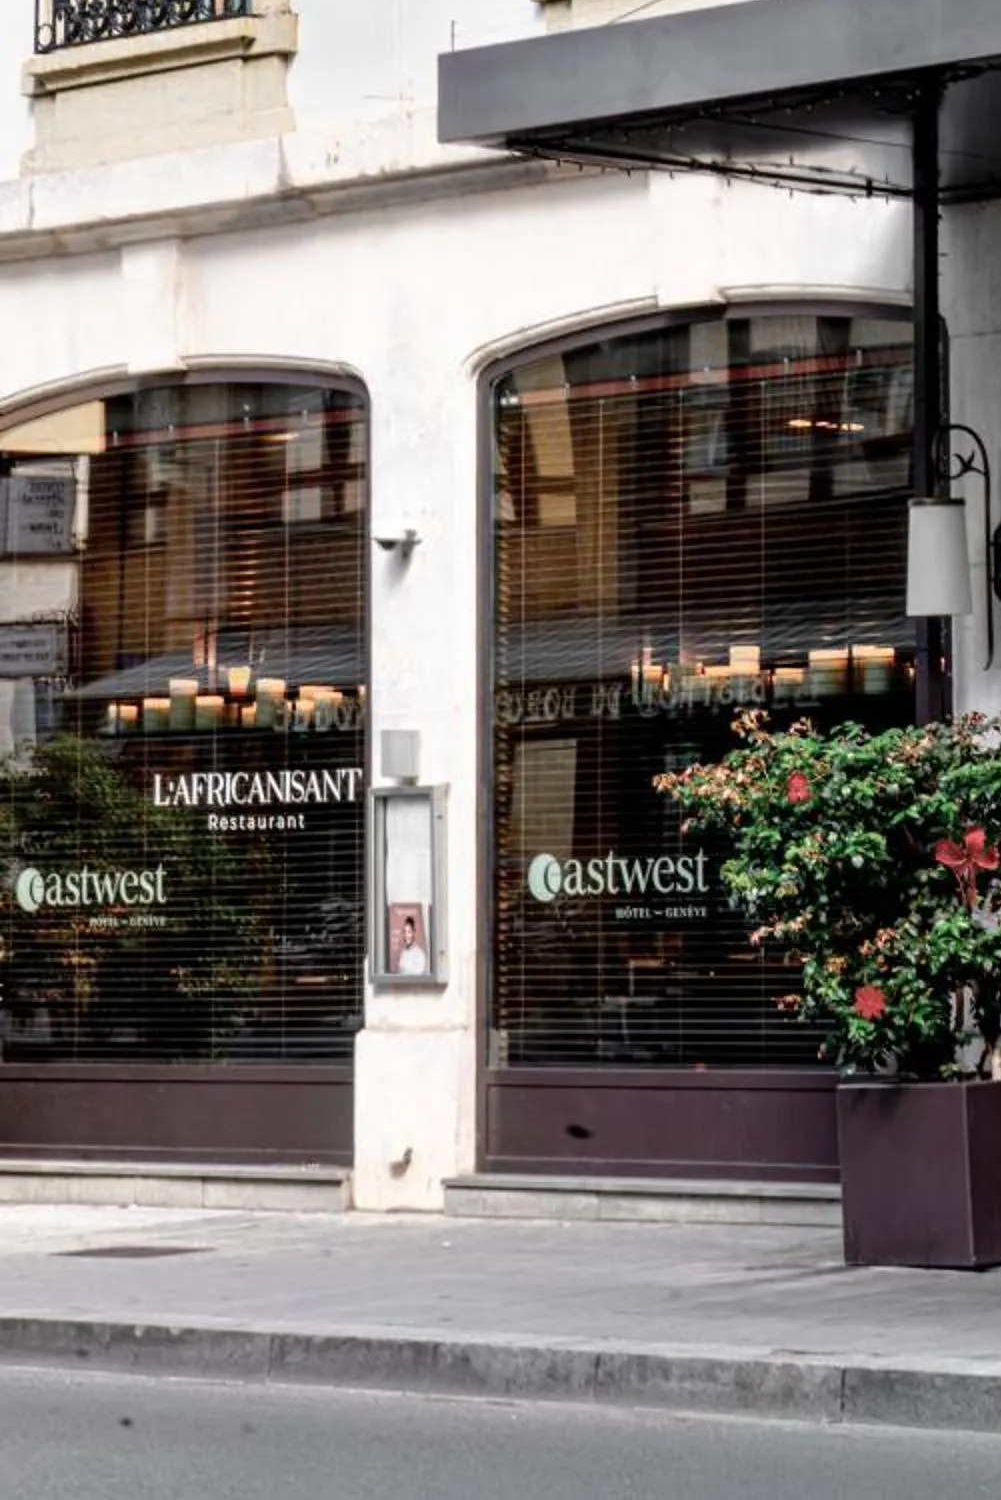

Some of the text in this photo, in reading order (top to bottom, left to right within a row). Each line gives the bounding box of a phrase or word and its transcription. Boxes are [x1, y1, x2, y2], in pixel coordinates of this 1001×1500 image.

[208, 813, 305, 831] Restaurant
[16, 862, 168, 912] eastwest
[528, 847, 710, 902] eastwest
